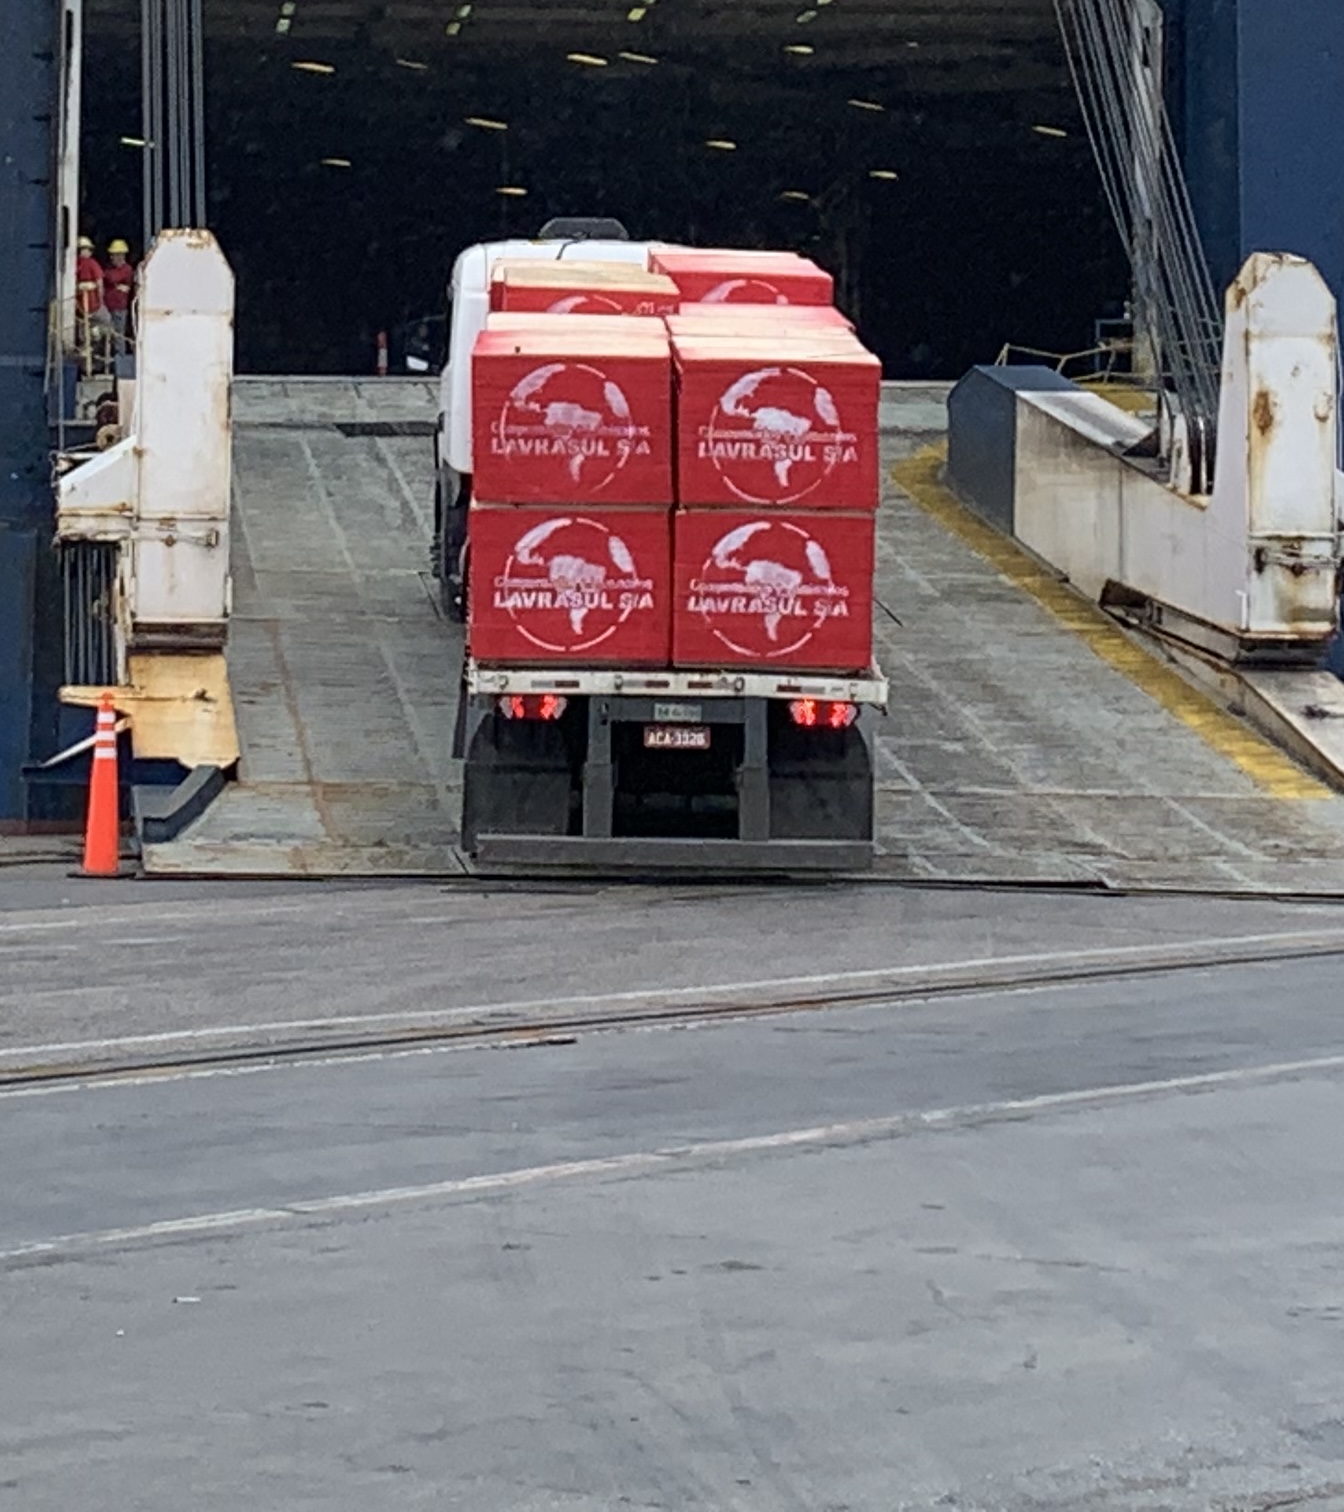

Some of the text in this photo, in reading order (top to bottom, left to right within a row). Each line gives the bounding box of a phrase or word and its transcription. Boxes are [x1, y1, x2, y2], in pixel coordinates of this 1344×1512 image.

[492, 438, 609, 456] LAVRASUL
[698, 442, 816, 461] LAVRASUL
[494, 591, 613, 609] LAVRASUL
[688, 595, 807, 616] LAVRASUL
